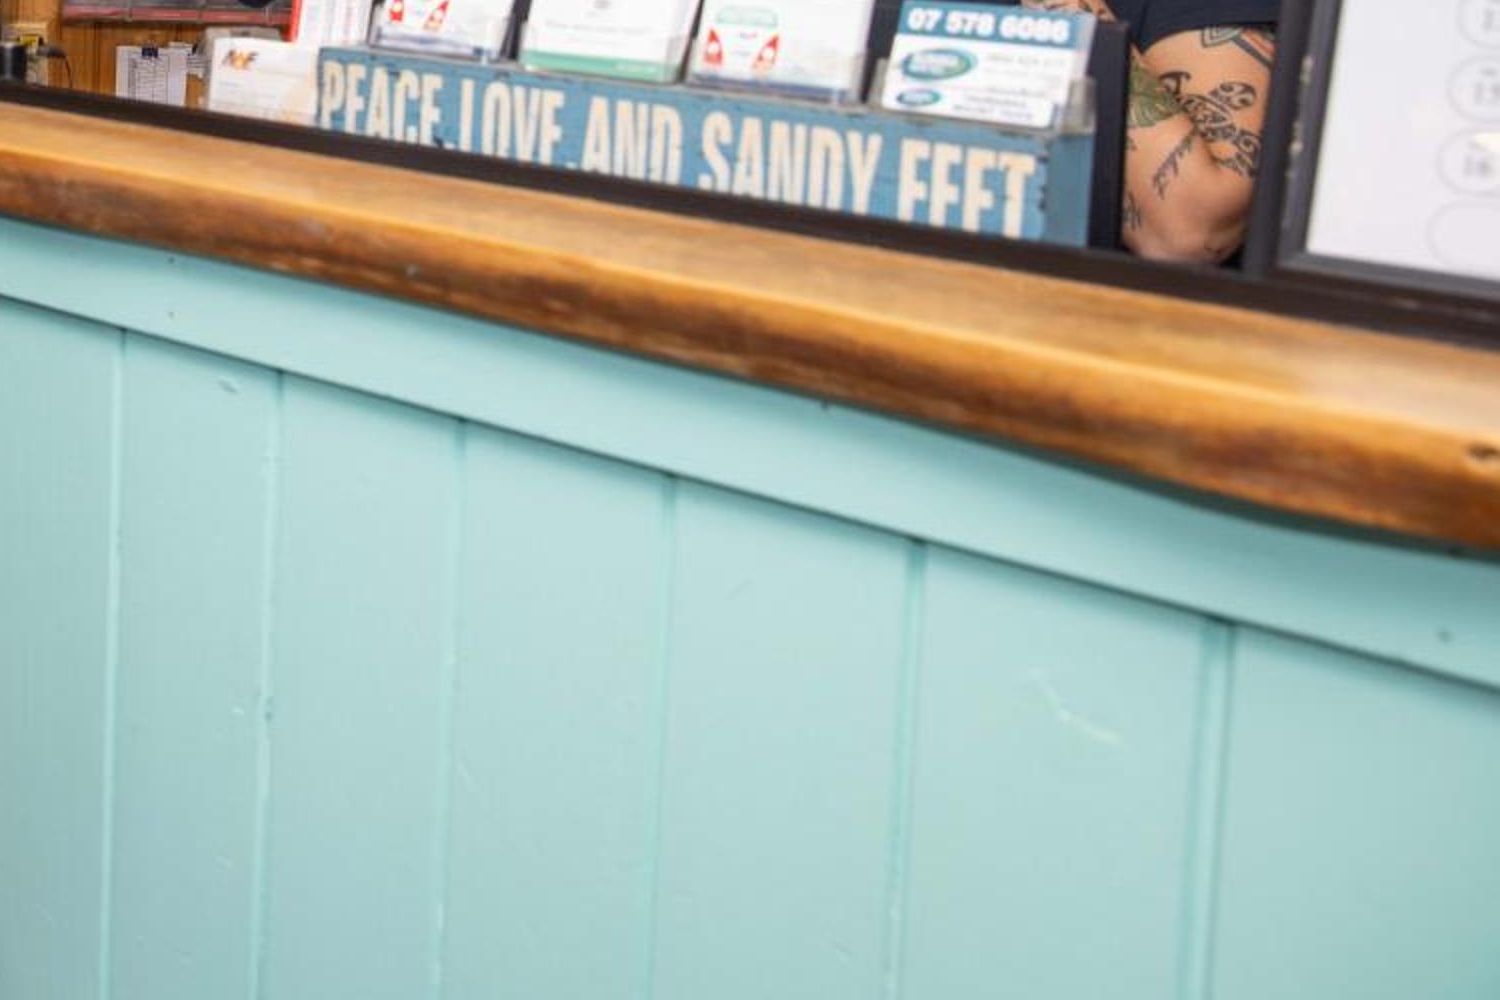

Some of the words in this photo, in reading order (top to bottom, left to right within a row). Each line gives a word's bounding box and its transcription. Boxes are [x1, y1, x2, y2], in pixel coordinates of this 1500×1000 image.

[906, 8, 942, 31] 07
[945, 11, 995, 37] 578
[322, 60, 457, 150] PEACE
[458, 79, 578, 169] LOVE
[582, 97, 683, 185] AND
[698, 111, 882, 215] SANDY
[900, 137, 1036, 239] FEET
